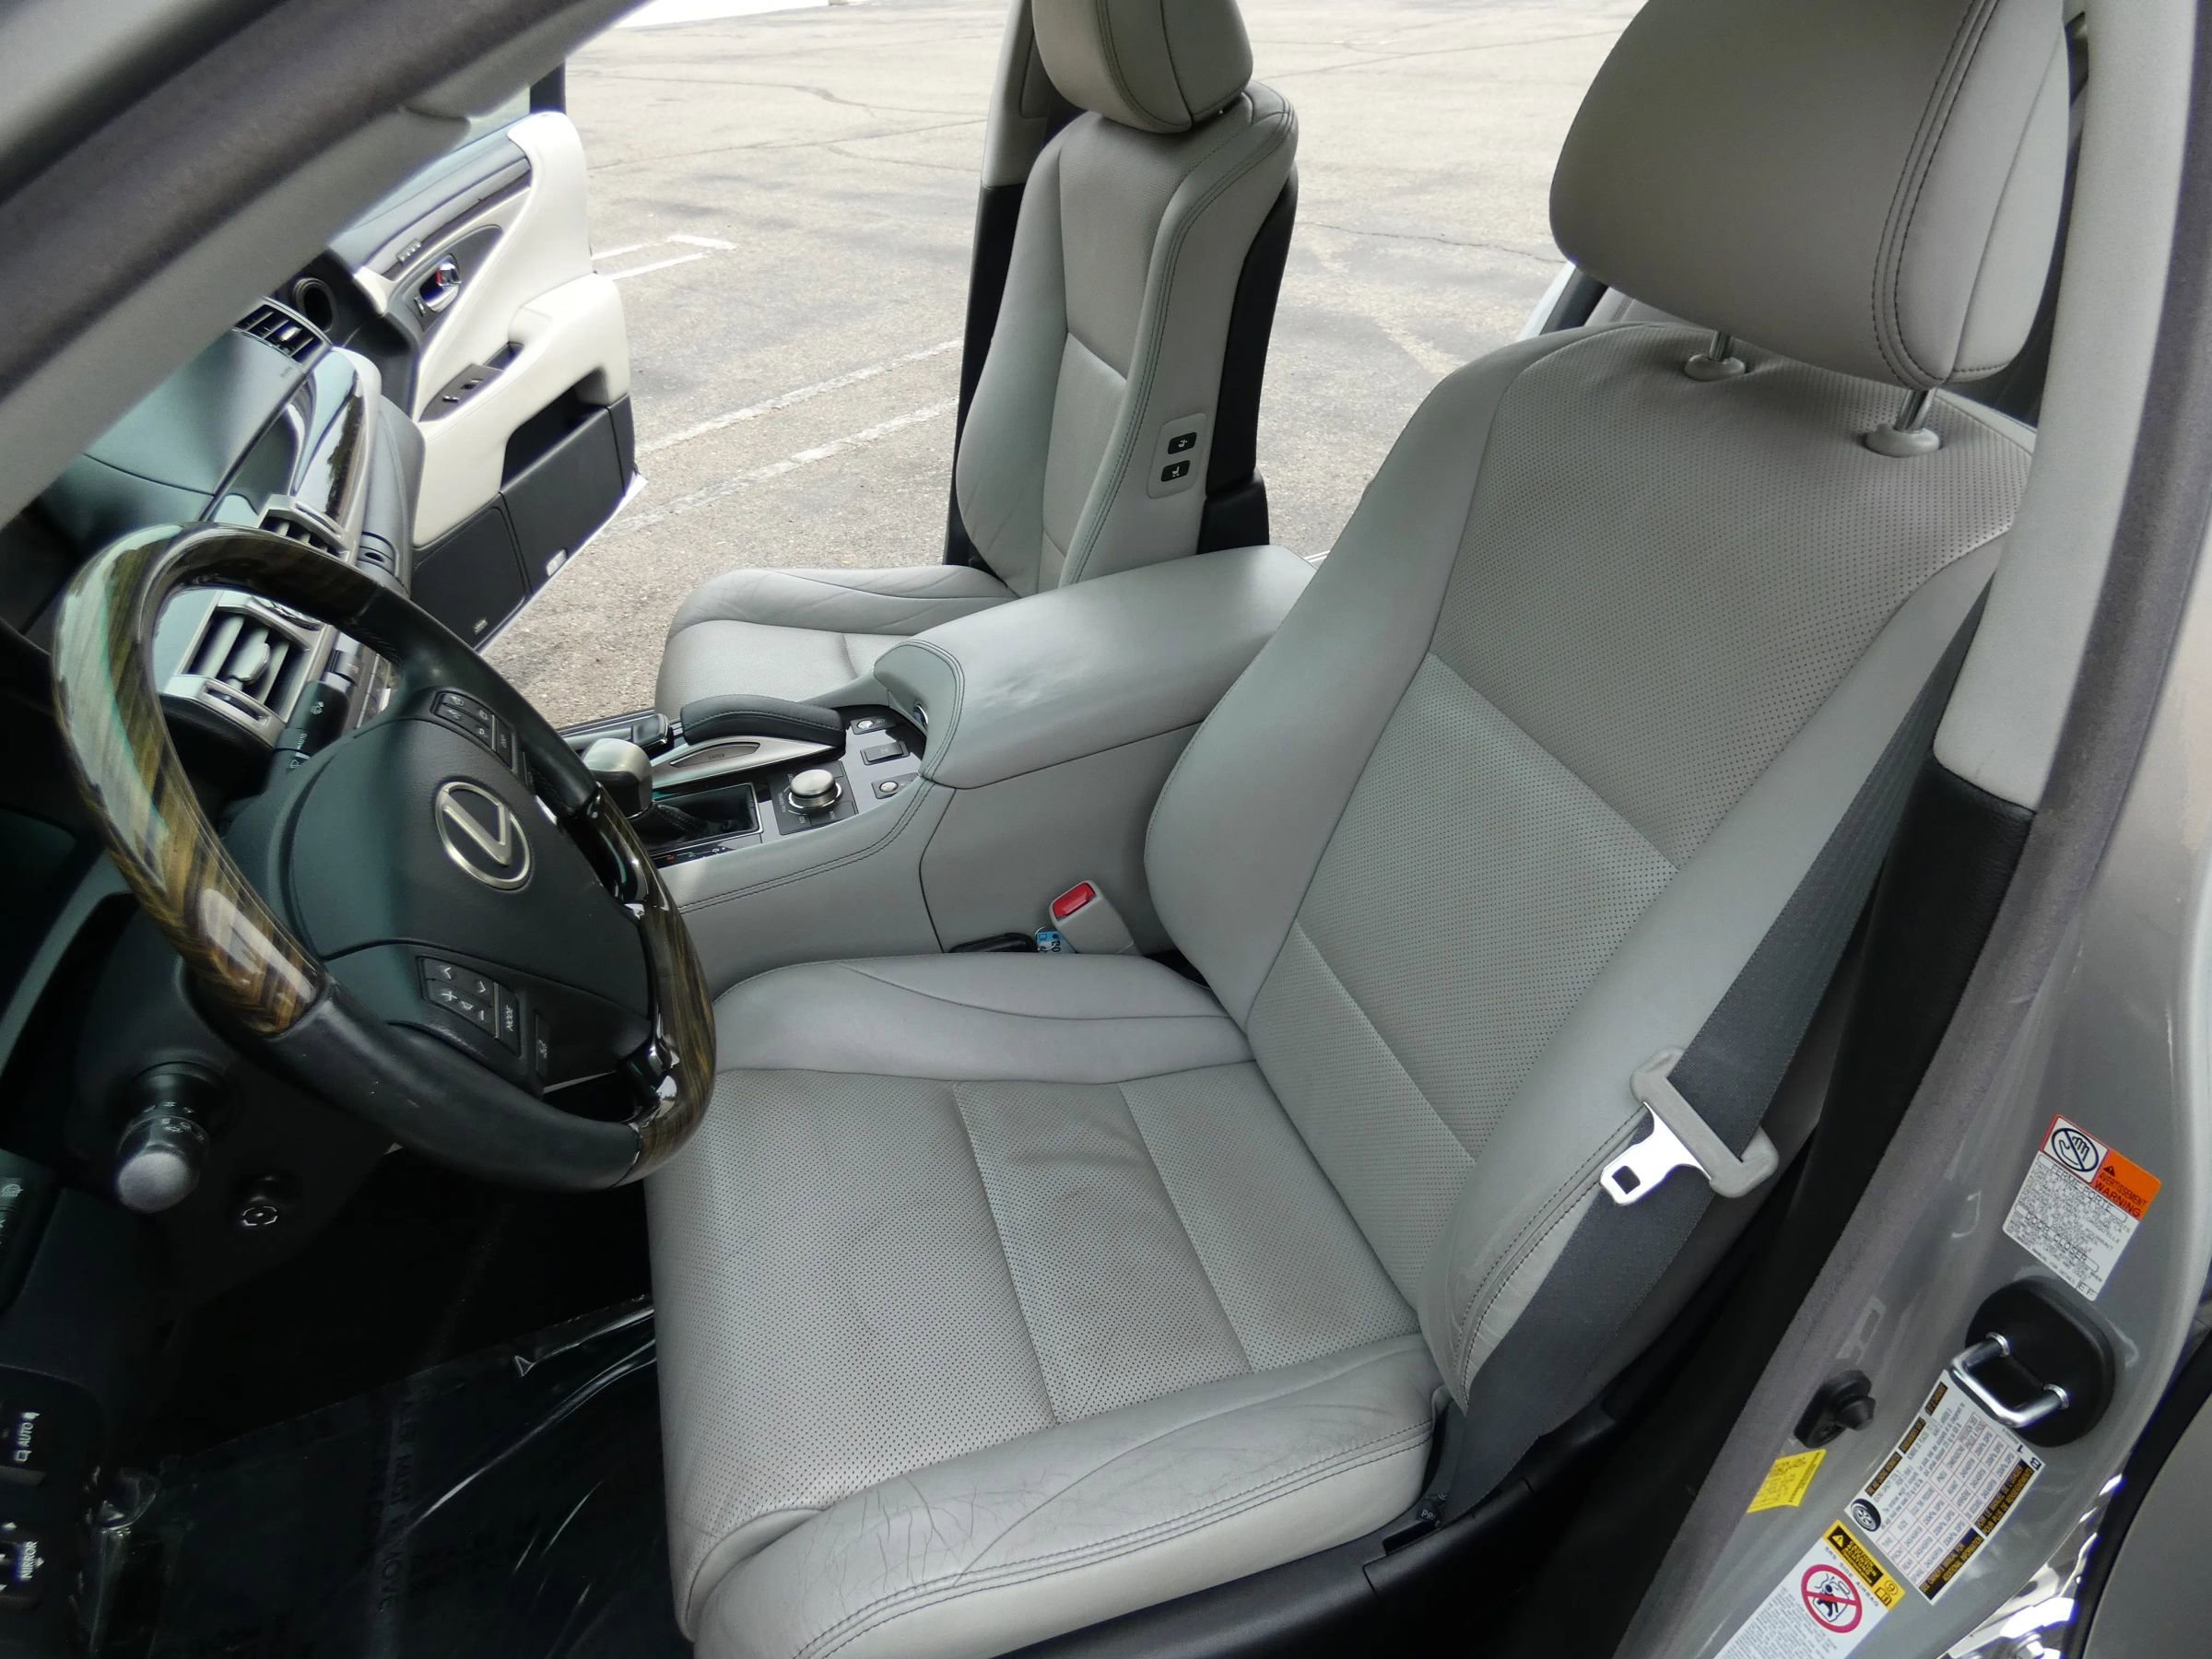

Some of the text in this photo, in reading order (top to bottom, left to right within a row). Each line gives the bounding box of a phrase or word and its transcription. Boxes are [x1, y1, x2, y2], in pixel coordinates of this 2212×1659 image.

[505, 1004, 513, 1031] MODE
[2050, 1163, 2113, 1213] FERME-PORTE
[2092, 1179, 2142, 1218] WARNING
[2024, 1210, 2088, 1264] DOOR CLOSER
[19, 1422, 34, 1447] AUTO
[2028, 1455, 2042, 1471] B
[20, 1541, 38, 1580] MIRROR
[1855, 1580, 1880, 1607] AIRBAG
